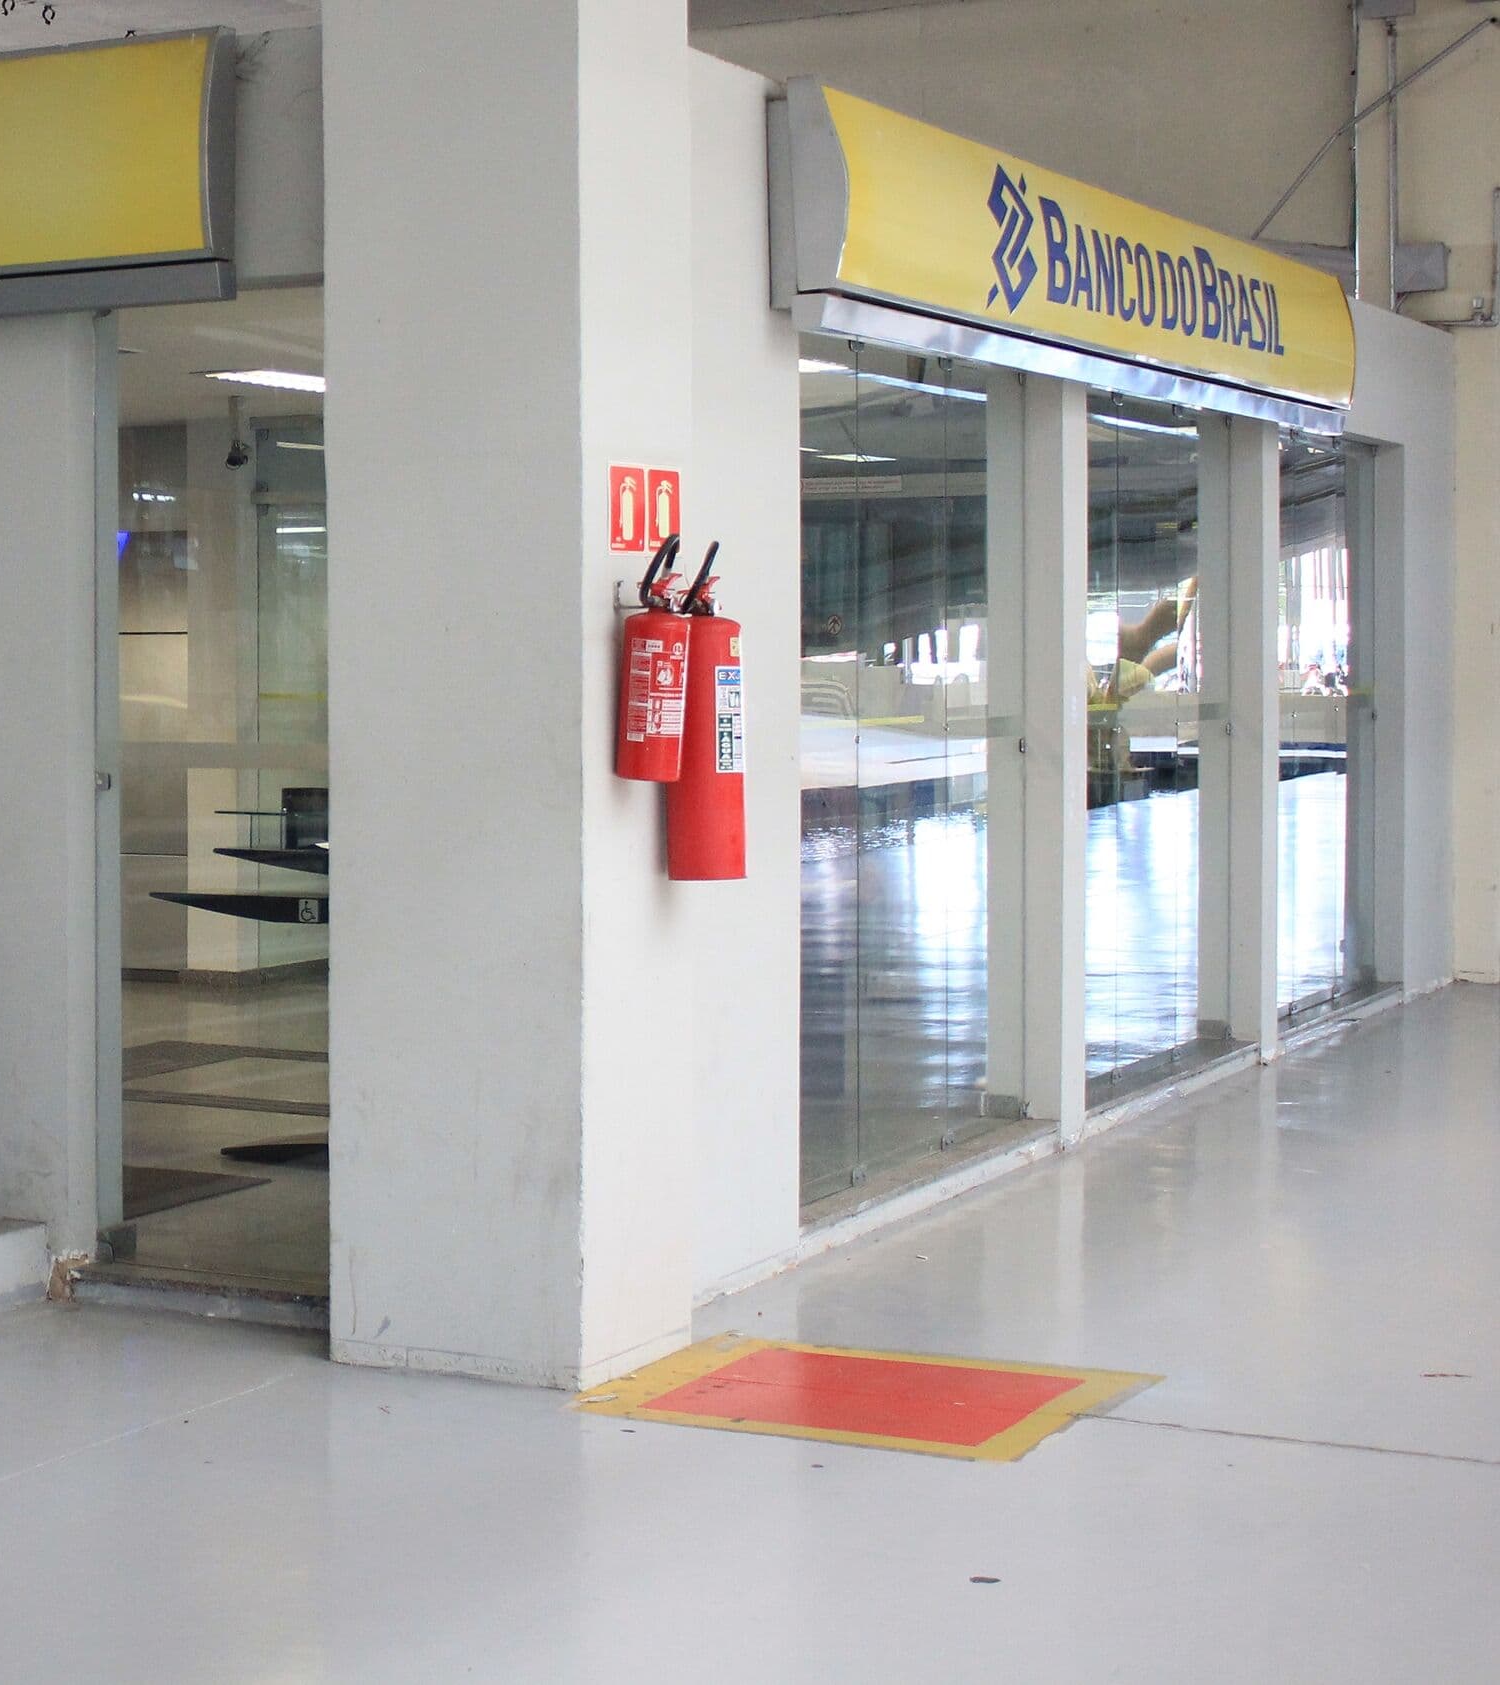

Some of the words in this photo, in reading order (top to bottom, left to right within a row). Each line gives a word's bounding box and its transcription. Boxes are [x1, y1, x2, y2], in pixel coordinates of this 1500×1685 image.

[1038, 196, 1155, 327] BANCO
[1156, 250, 1198, 337] DO
[1193, 245, 1285, 355] BRASIL
